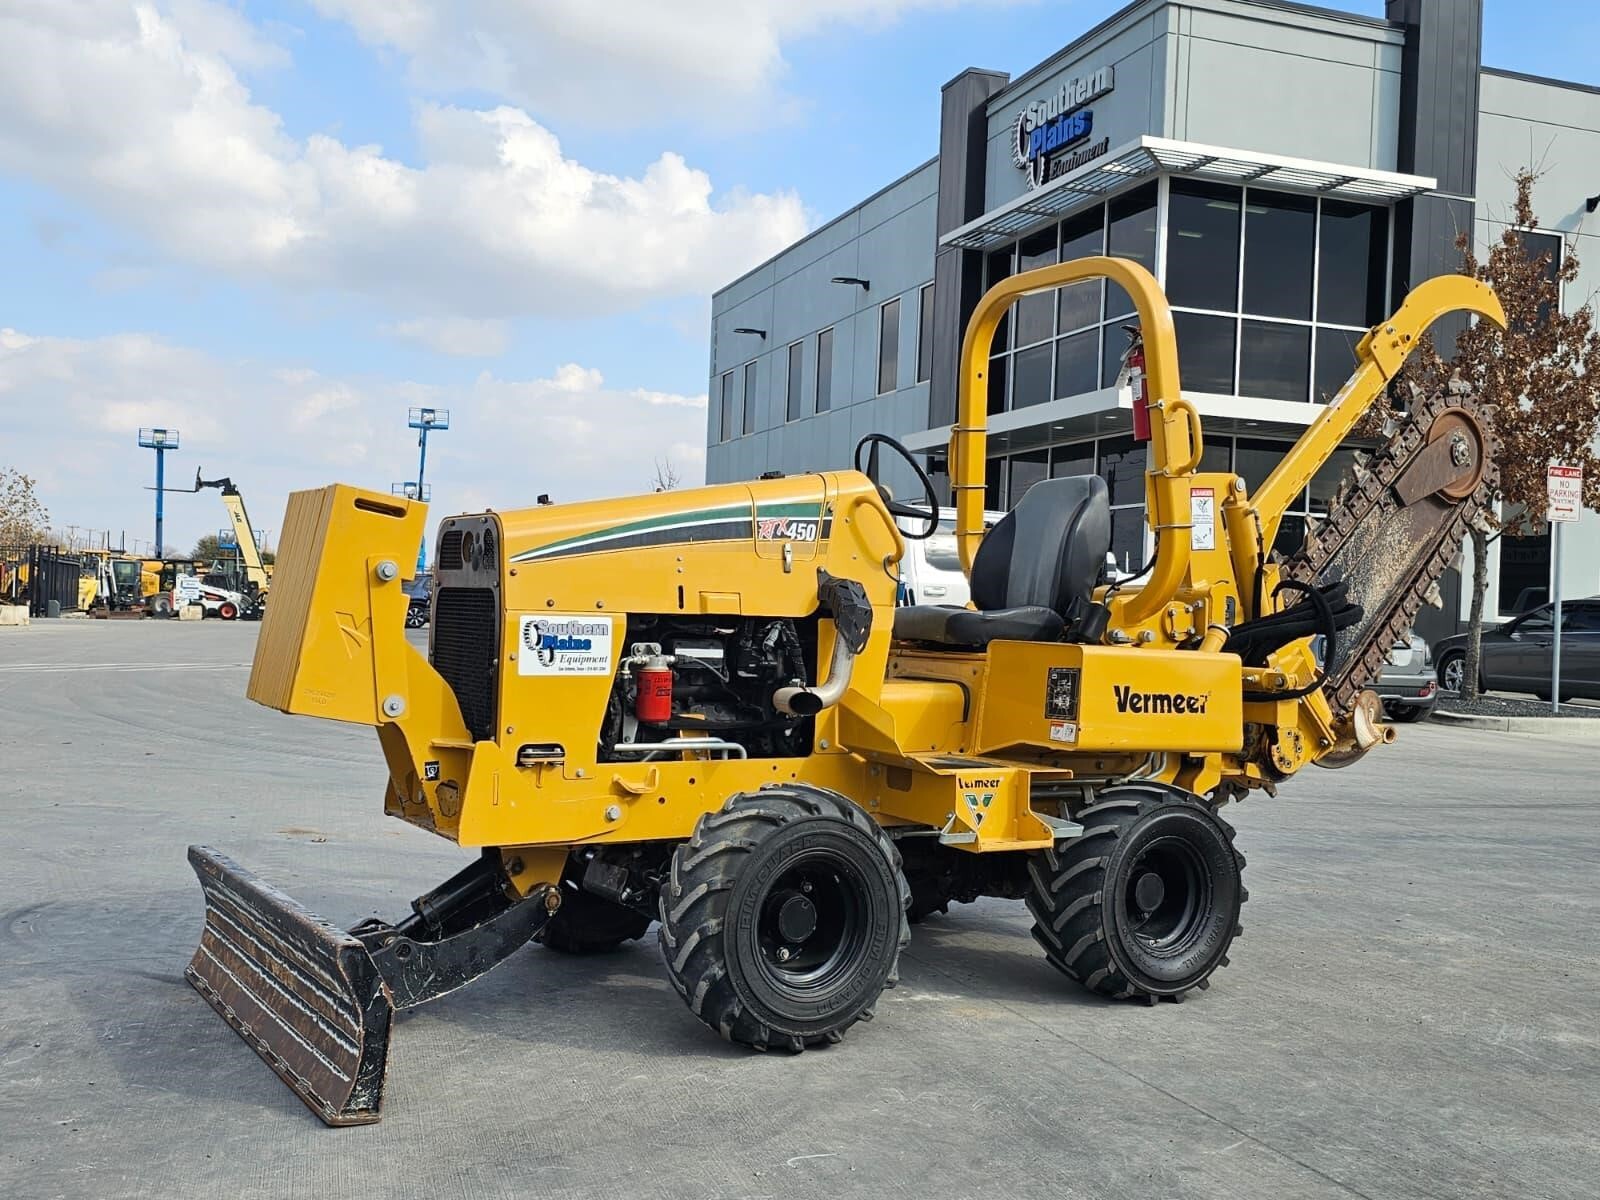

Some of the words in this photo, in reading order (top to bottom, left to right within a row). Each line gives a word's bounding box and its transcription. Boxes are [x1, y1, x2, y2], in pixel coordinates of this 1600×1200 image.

[1026, 66, 1111, 132] Southern
[1029, 110, 1093, 161] Plains
[1051, 137, 1109, 178] Equipment
[1564, 469, 1580, 477] LANE
[1559, 481, 1570, 489] NO
[1550, 489, 1579, 499] PARKING
[538, 620, 609, 636] Southern
[541, 635, 592, 650] Plains
[560, 653, 608, 666] Equipment
[1114, 685, 1208, 714] Vermeer
